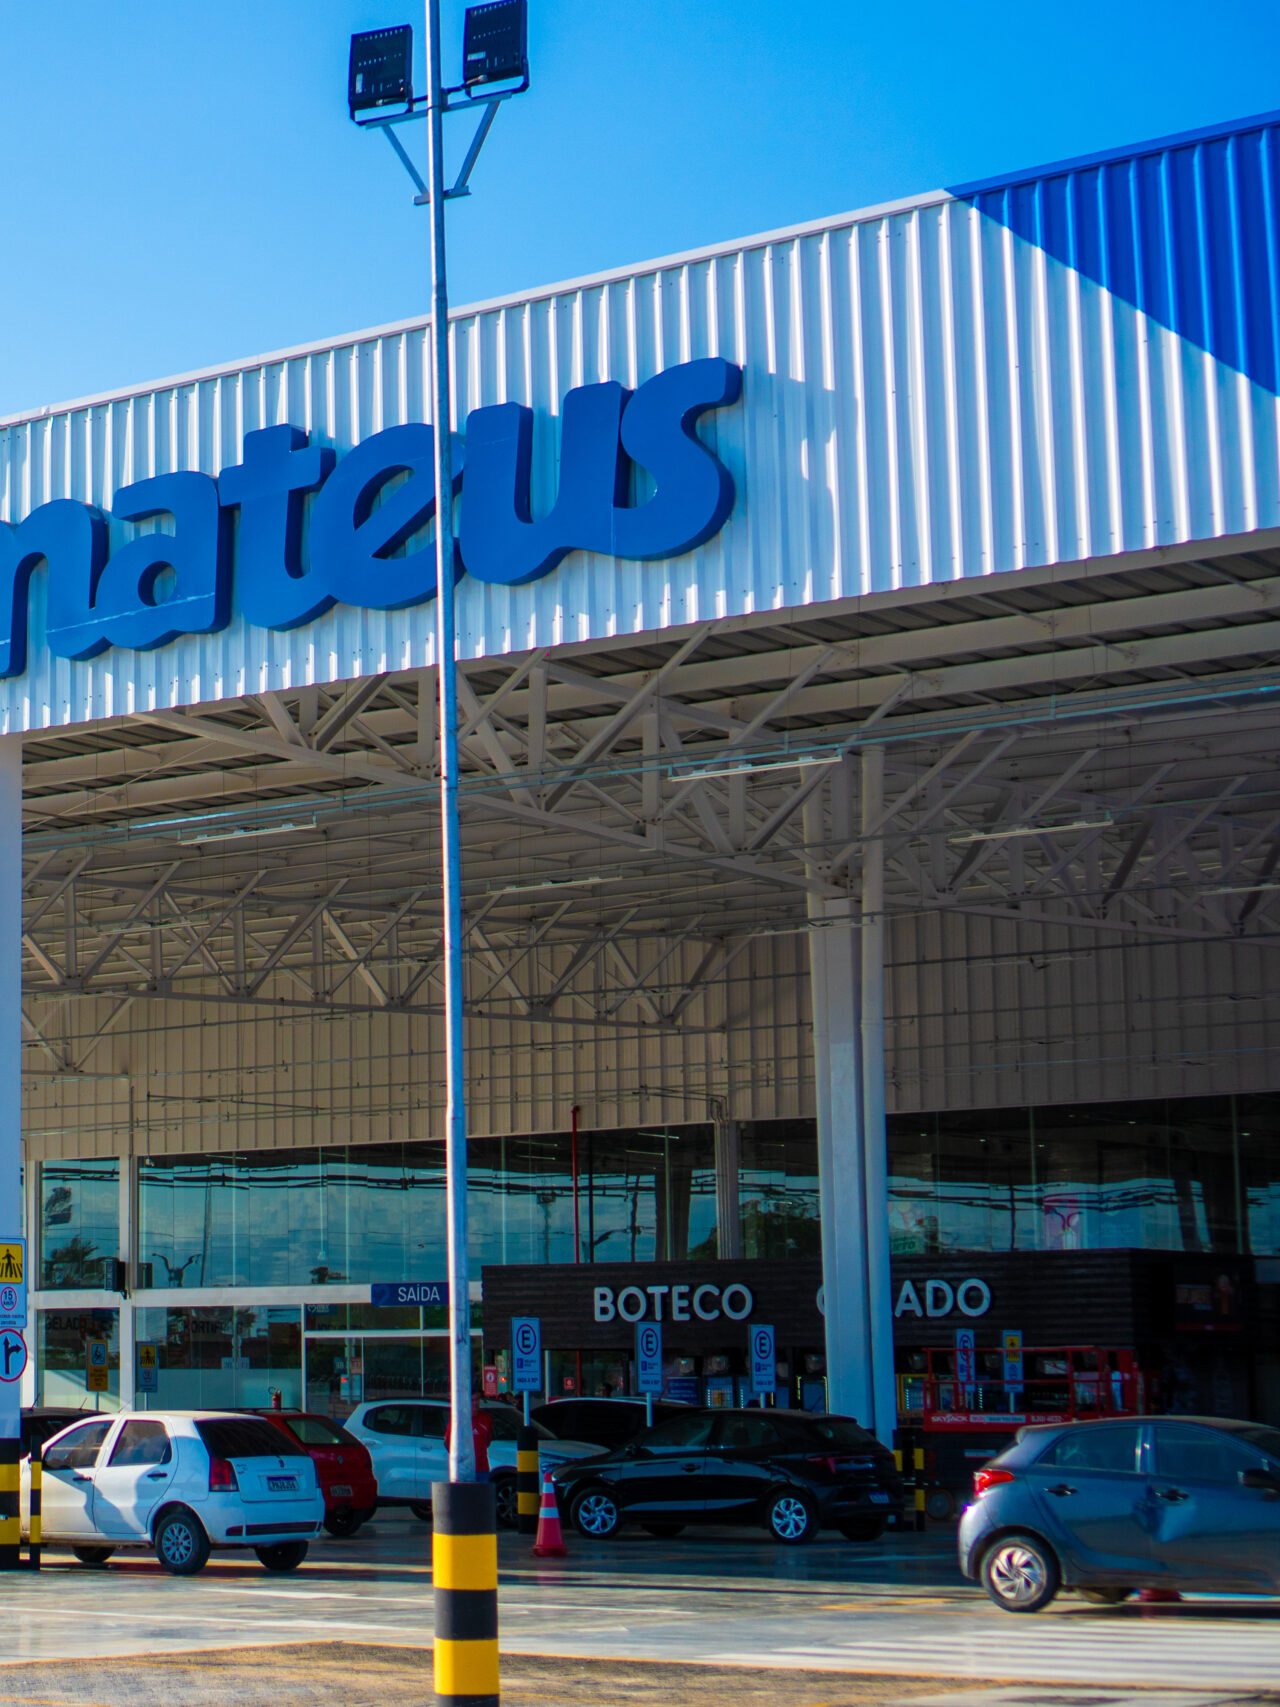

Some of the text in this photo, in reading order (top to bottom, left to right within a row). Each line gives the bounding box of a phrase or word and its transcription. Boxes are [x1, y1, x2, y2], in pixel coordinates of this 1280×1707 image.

[4, 1290, 13, 1300] 15
[398, 1284, 440, 1302] SAÍDA
[594, 1283, 753, 1322] BOTECO
[522, 1330, 531, 1348] E
